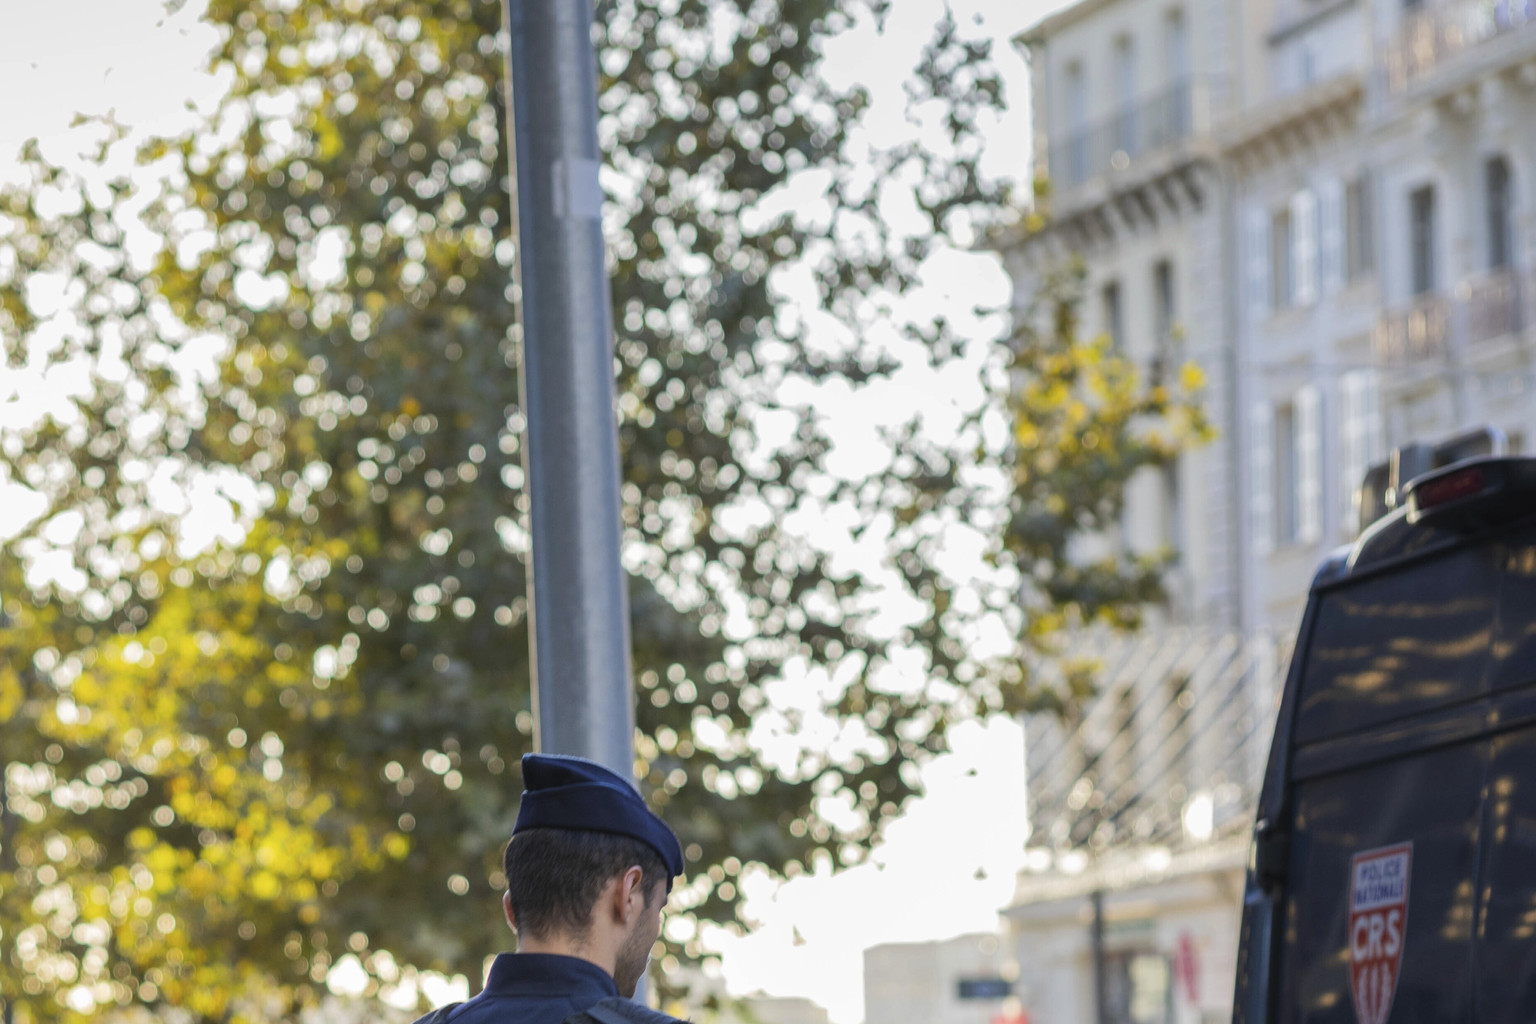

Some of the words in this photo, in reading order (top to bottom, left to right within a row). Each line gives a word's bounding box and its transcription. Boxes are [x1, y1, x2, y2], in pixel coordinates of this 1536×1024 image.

[1361, 858, 1401, 882] POLICE
[1355, 879, 1404, 905] NATIONALE
[1353, 909, 1401, 963] CRS
